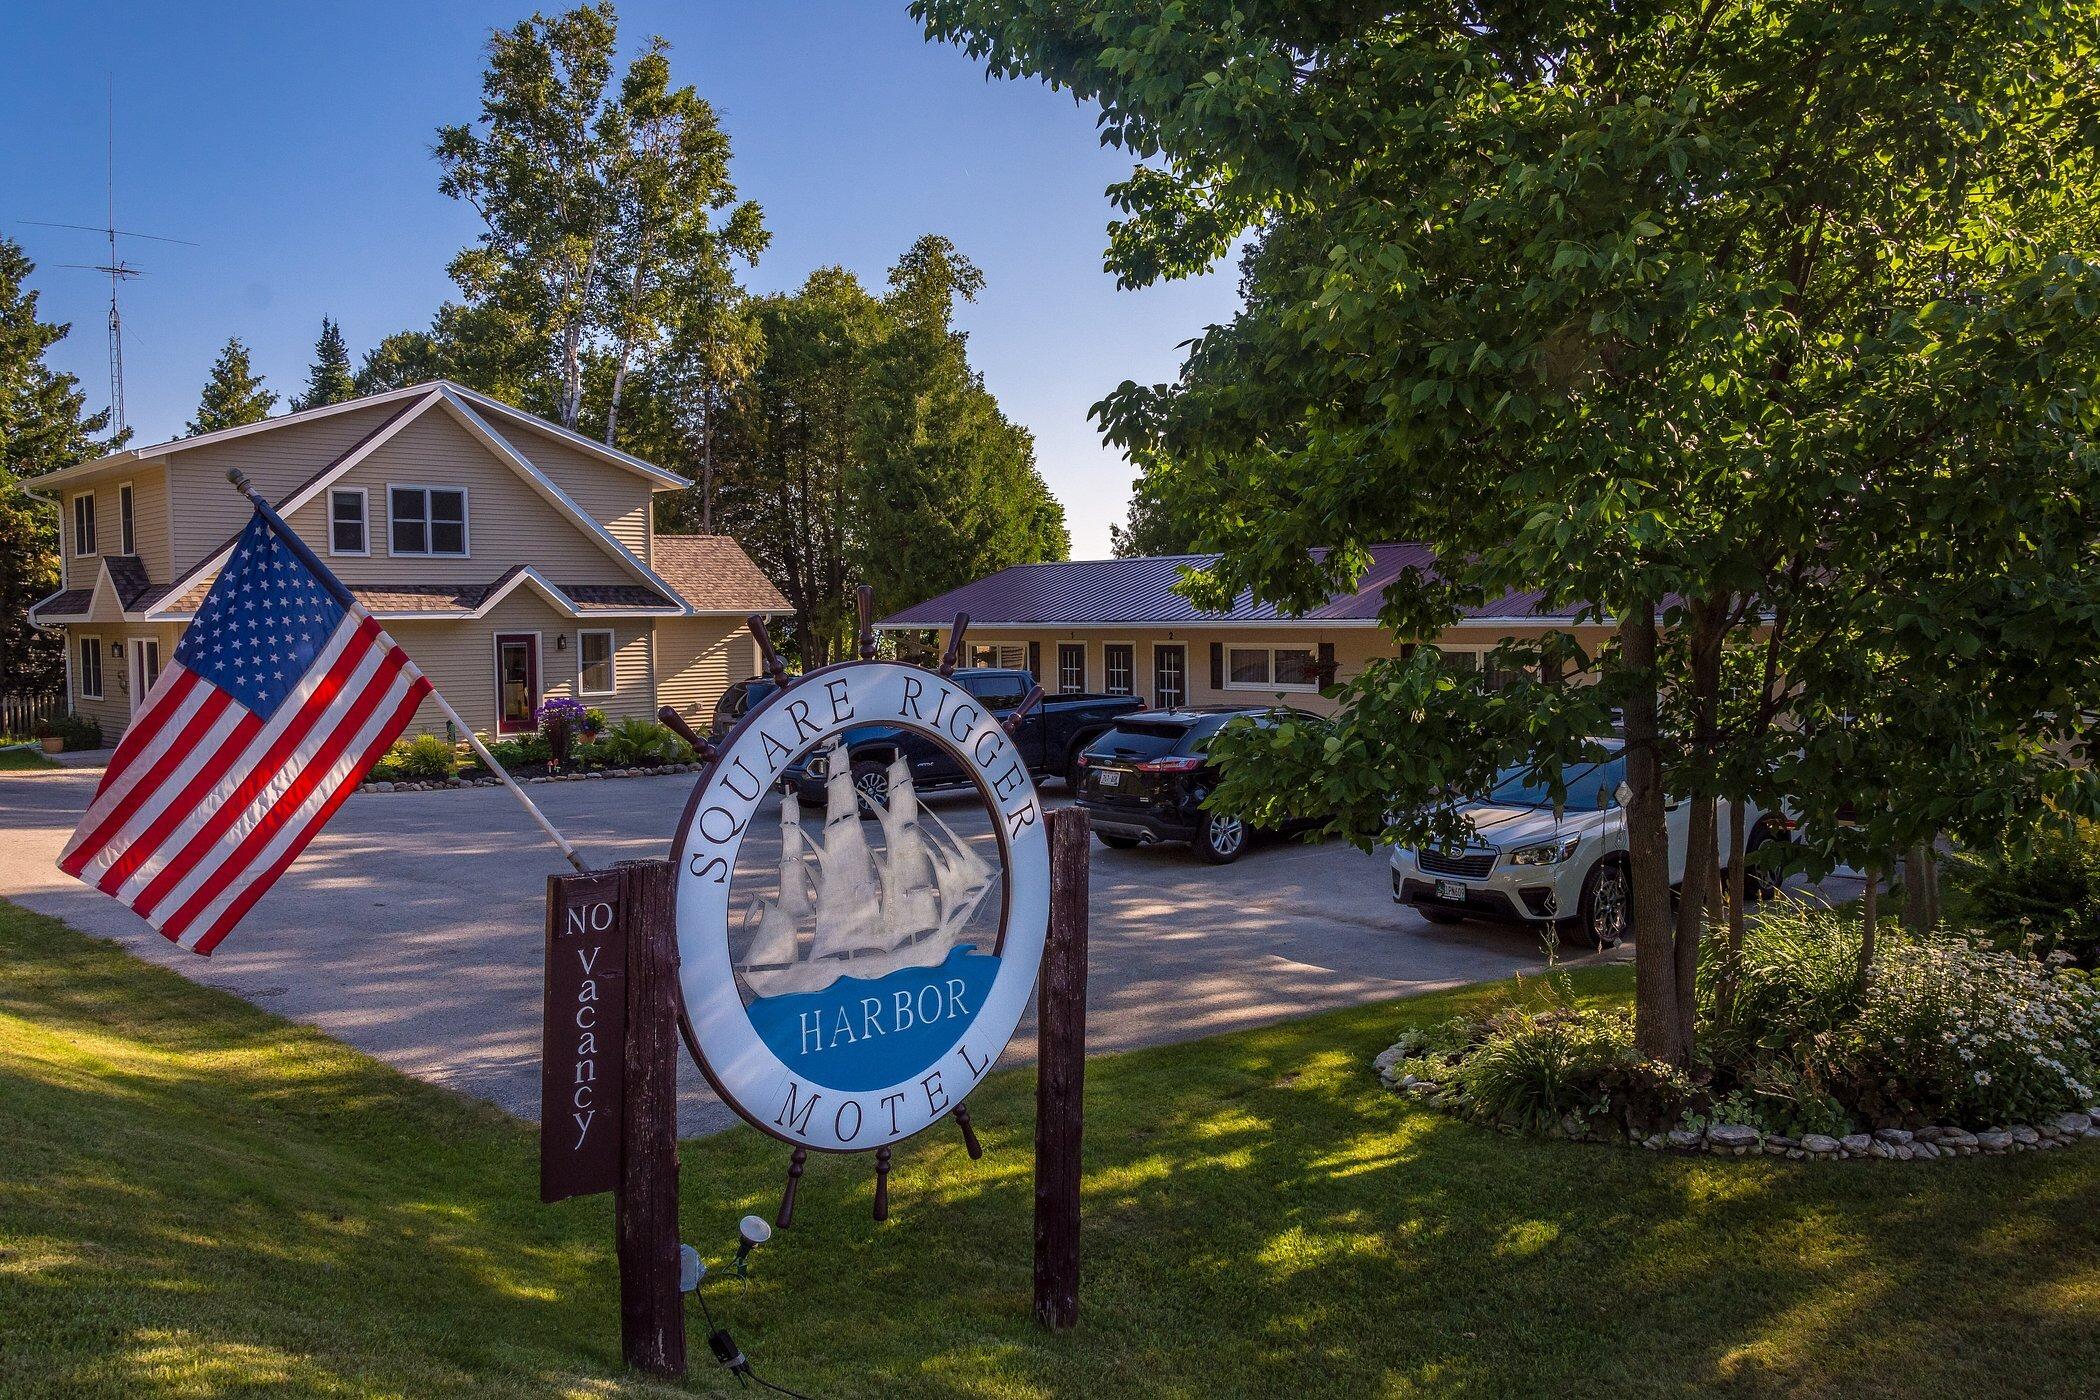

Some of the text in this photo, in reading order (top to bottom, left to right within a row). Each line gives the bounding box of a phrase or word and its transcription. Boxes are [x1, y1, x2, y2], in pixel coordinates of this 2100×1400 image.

[691, 675, 1036, 884] SQUARE RIGGER
[566, 902, 613, 935] NO
[799, 978, 969, 1054] HARBOR
[775, 1043, 990, 1143] MOTEL
